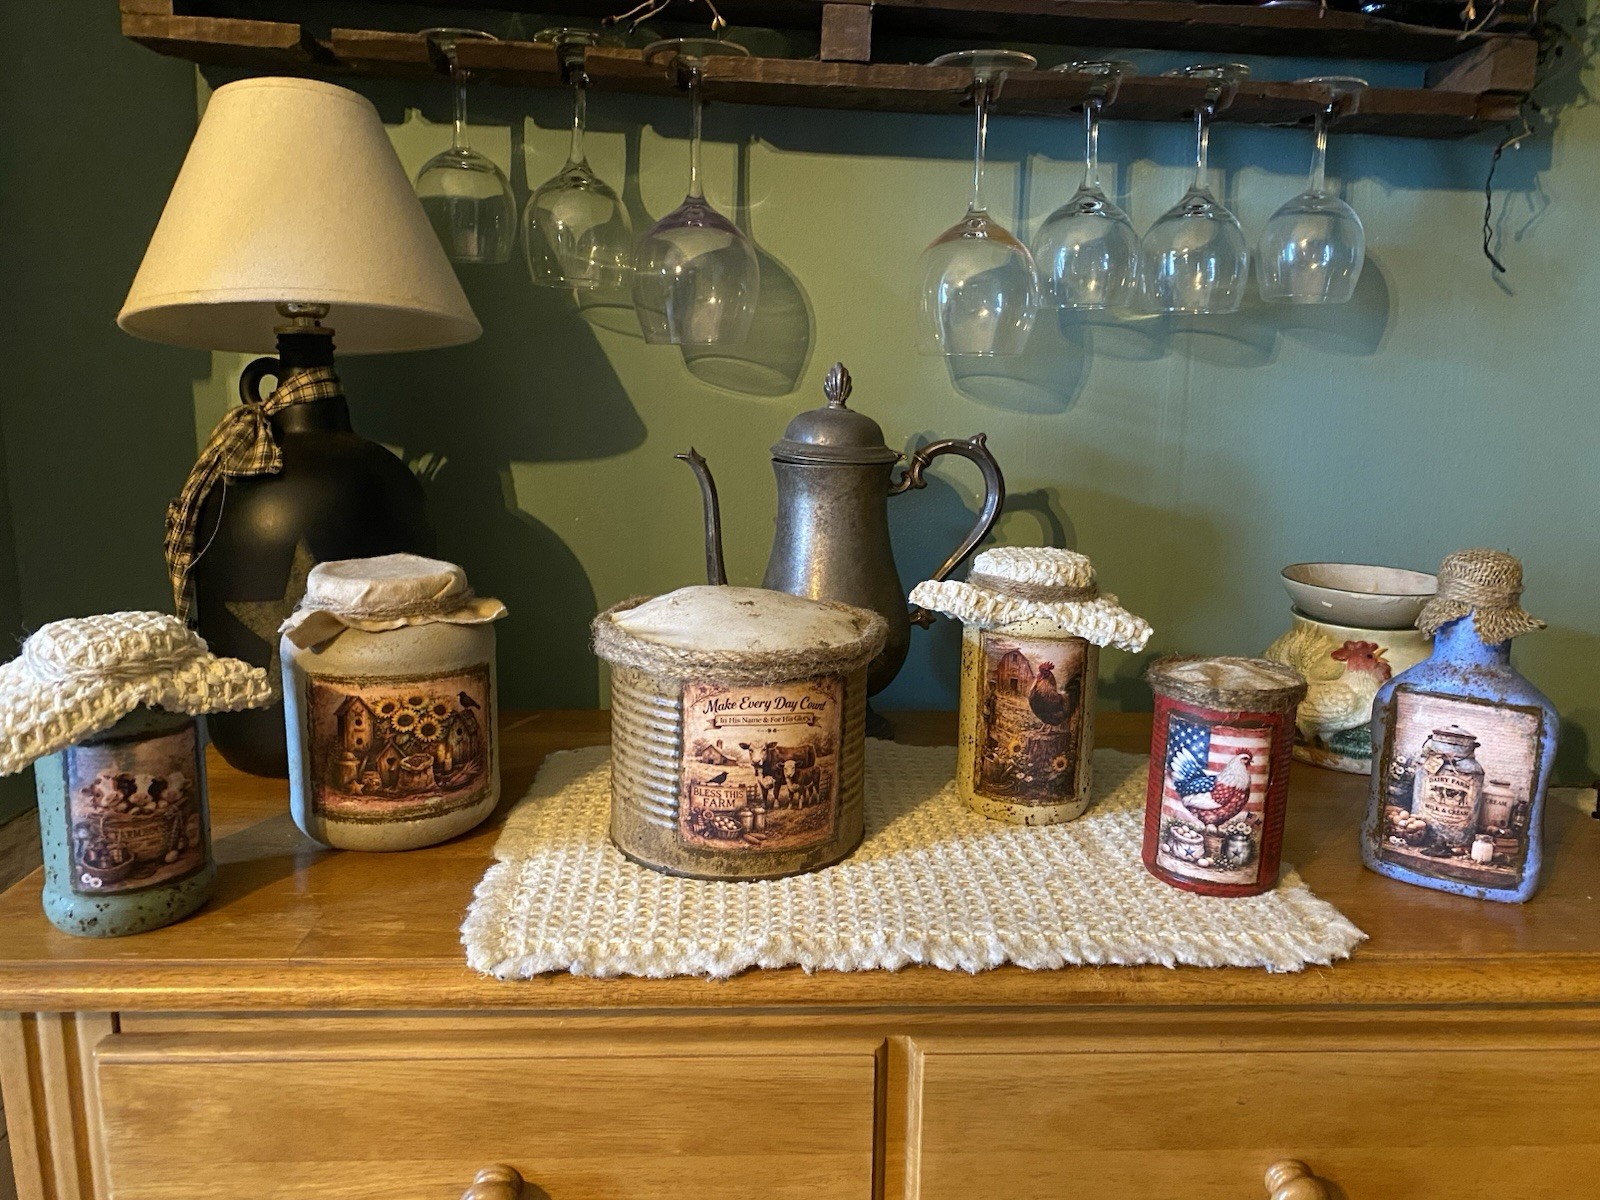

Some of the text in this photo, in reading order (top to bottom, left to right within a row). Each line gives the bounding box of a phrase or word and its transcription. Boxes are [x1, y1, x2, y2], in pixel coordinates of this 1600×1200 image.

[703, 696, 827, 714] Make Every Day Count
[1451, 778, 1470, 789] FARM
[694, 787, 744, 798] BLESS THIS
[703, 798, 735, 807] FARM
